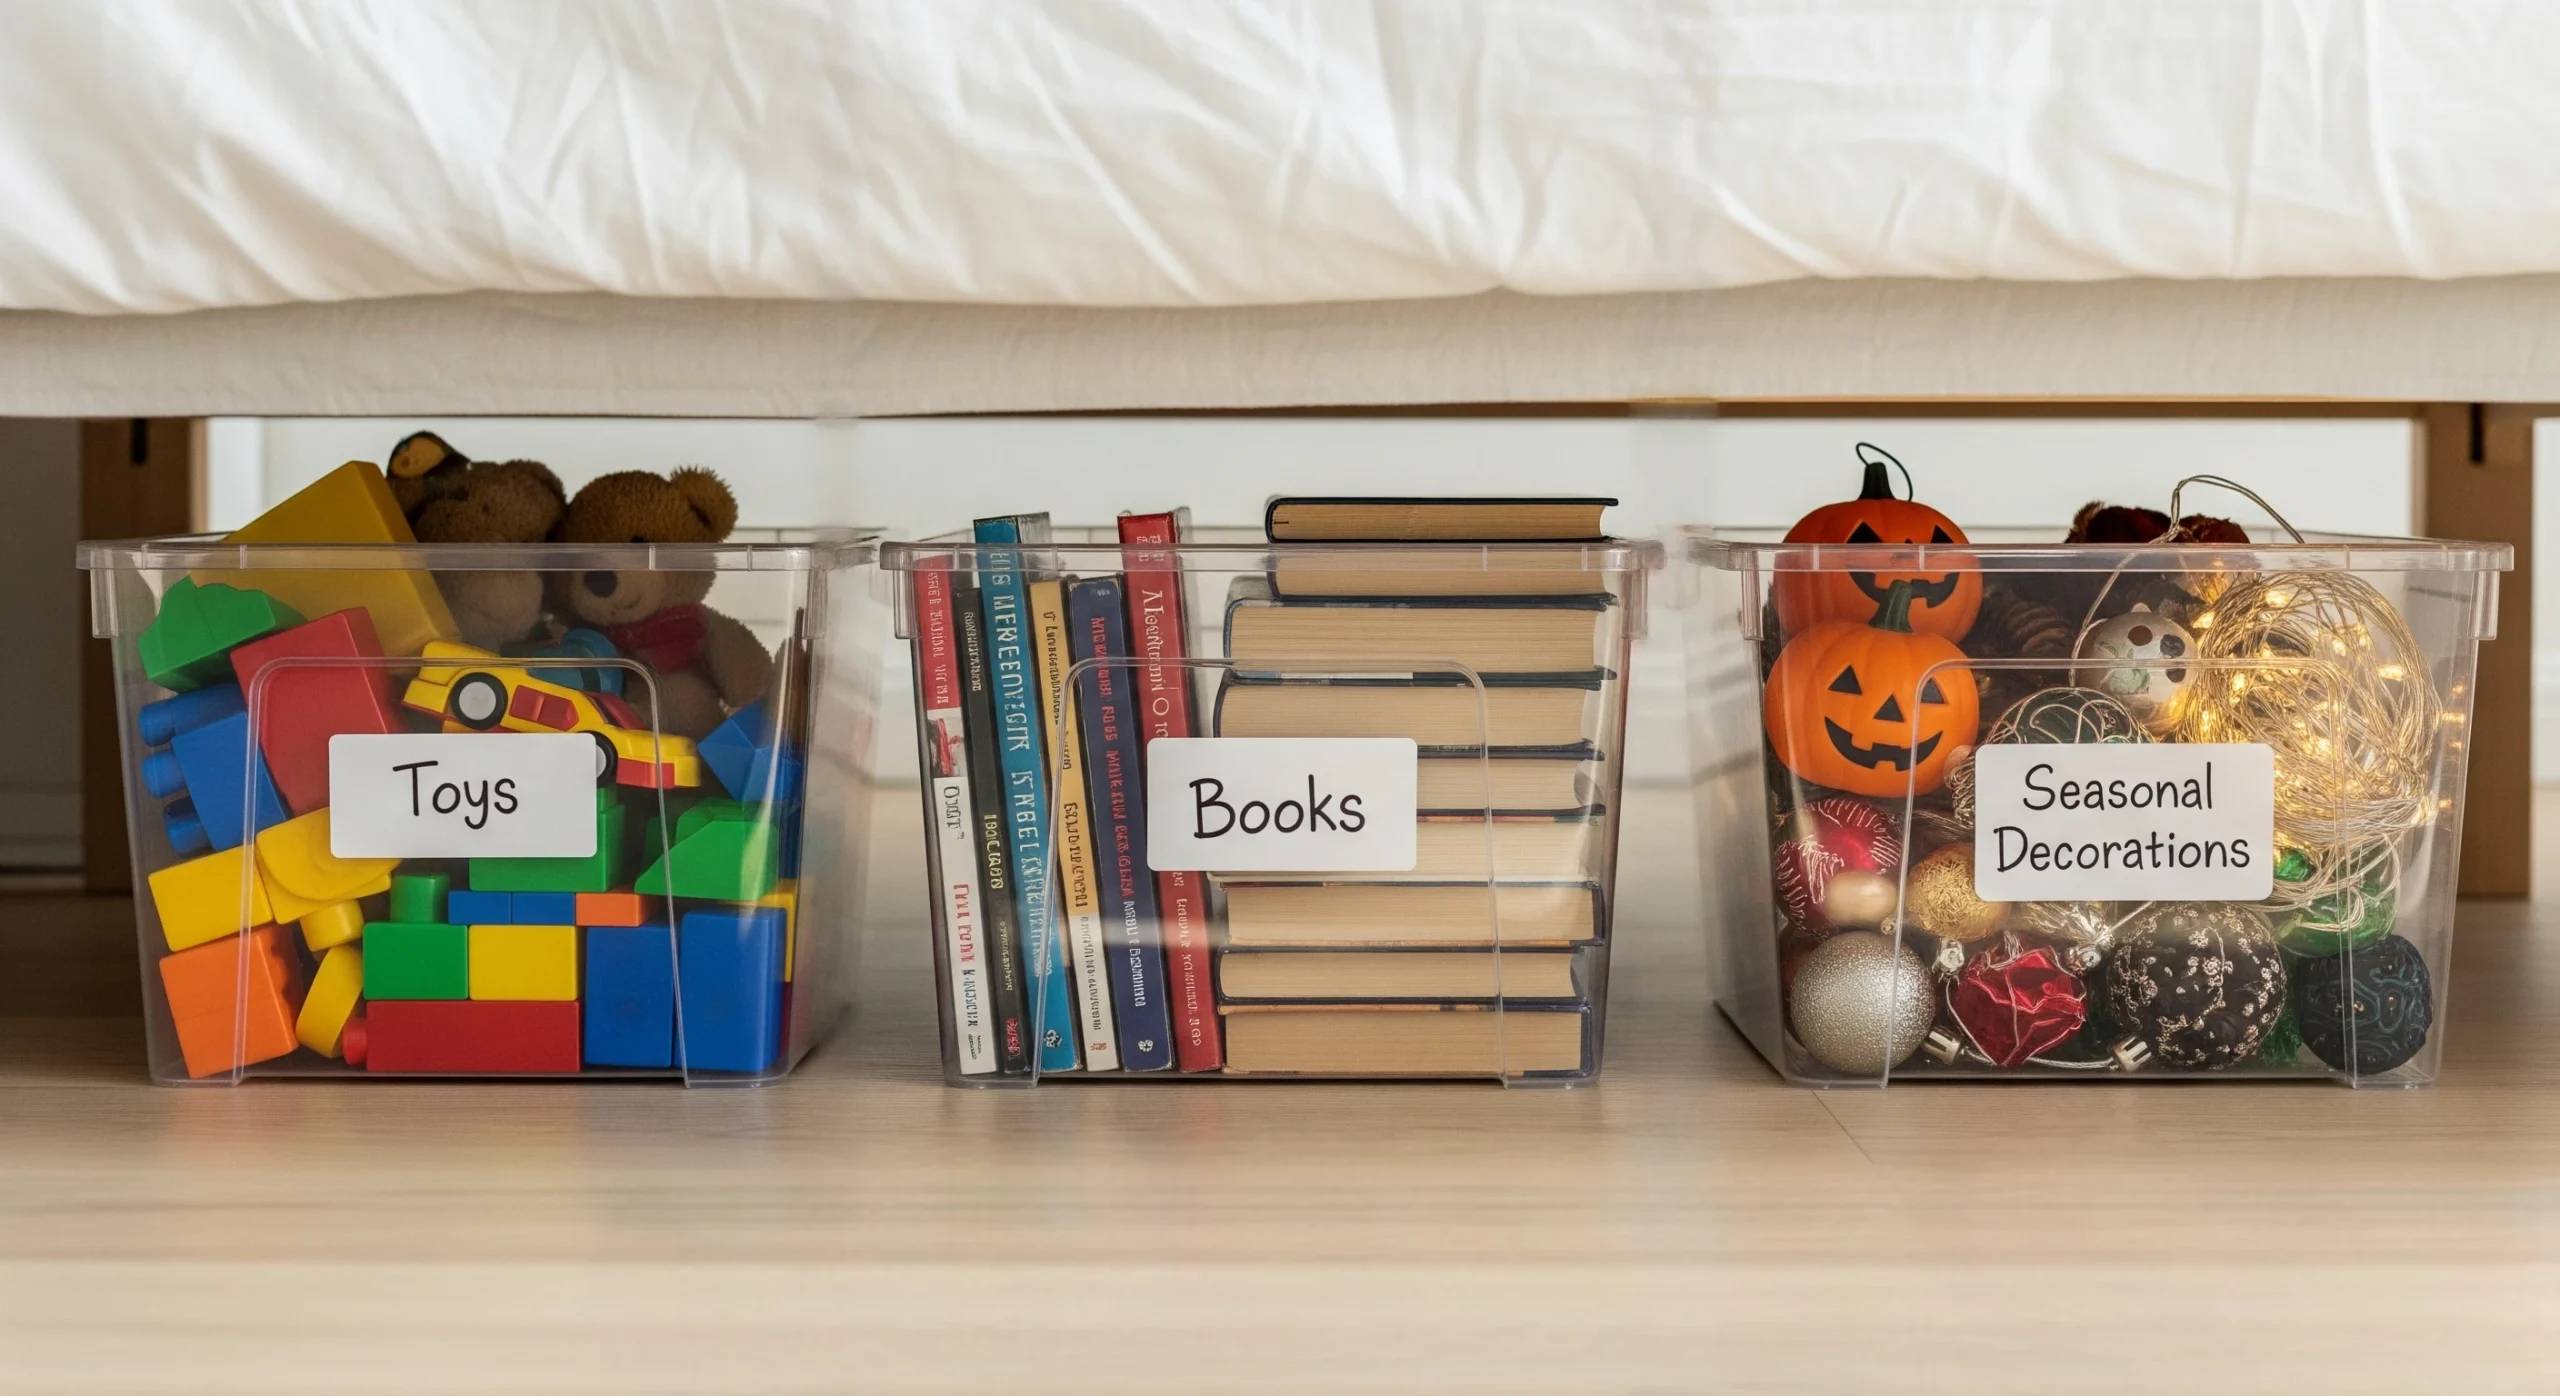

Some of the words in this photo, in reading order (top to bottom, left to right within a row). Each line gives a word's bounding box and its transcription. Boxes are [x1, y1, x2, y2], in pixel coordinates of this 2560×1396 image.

[392, 760, 519, 830] Toys
[1188, 774, 1366, 840] Books
[2022, 761, 2213, 811] Seasonal
[1993, 825, 2251, 873] Decorations
